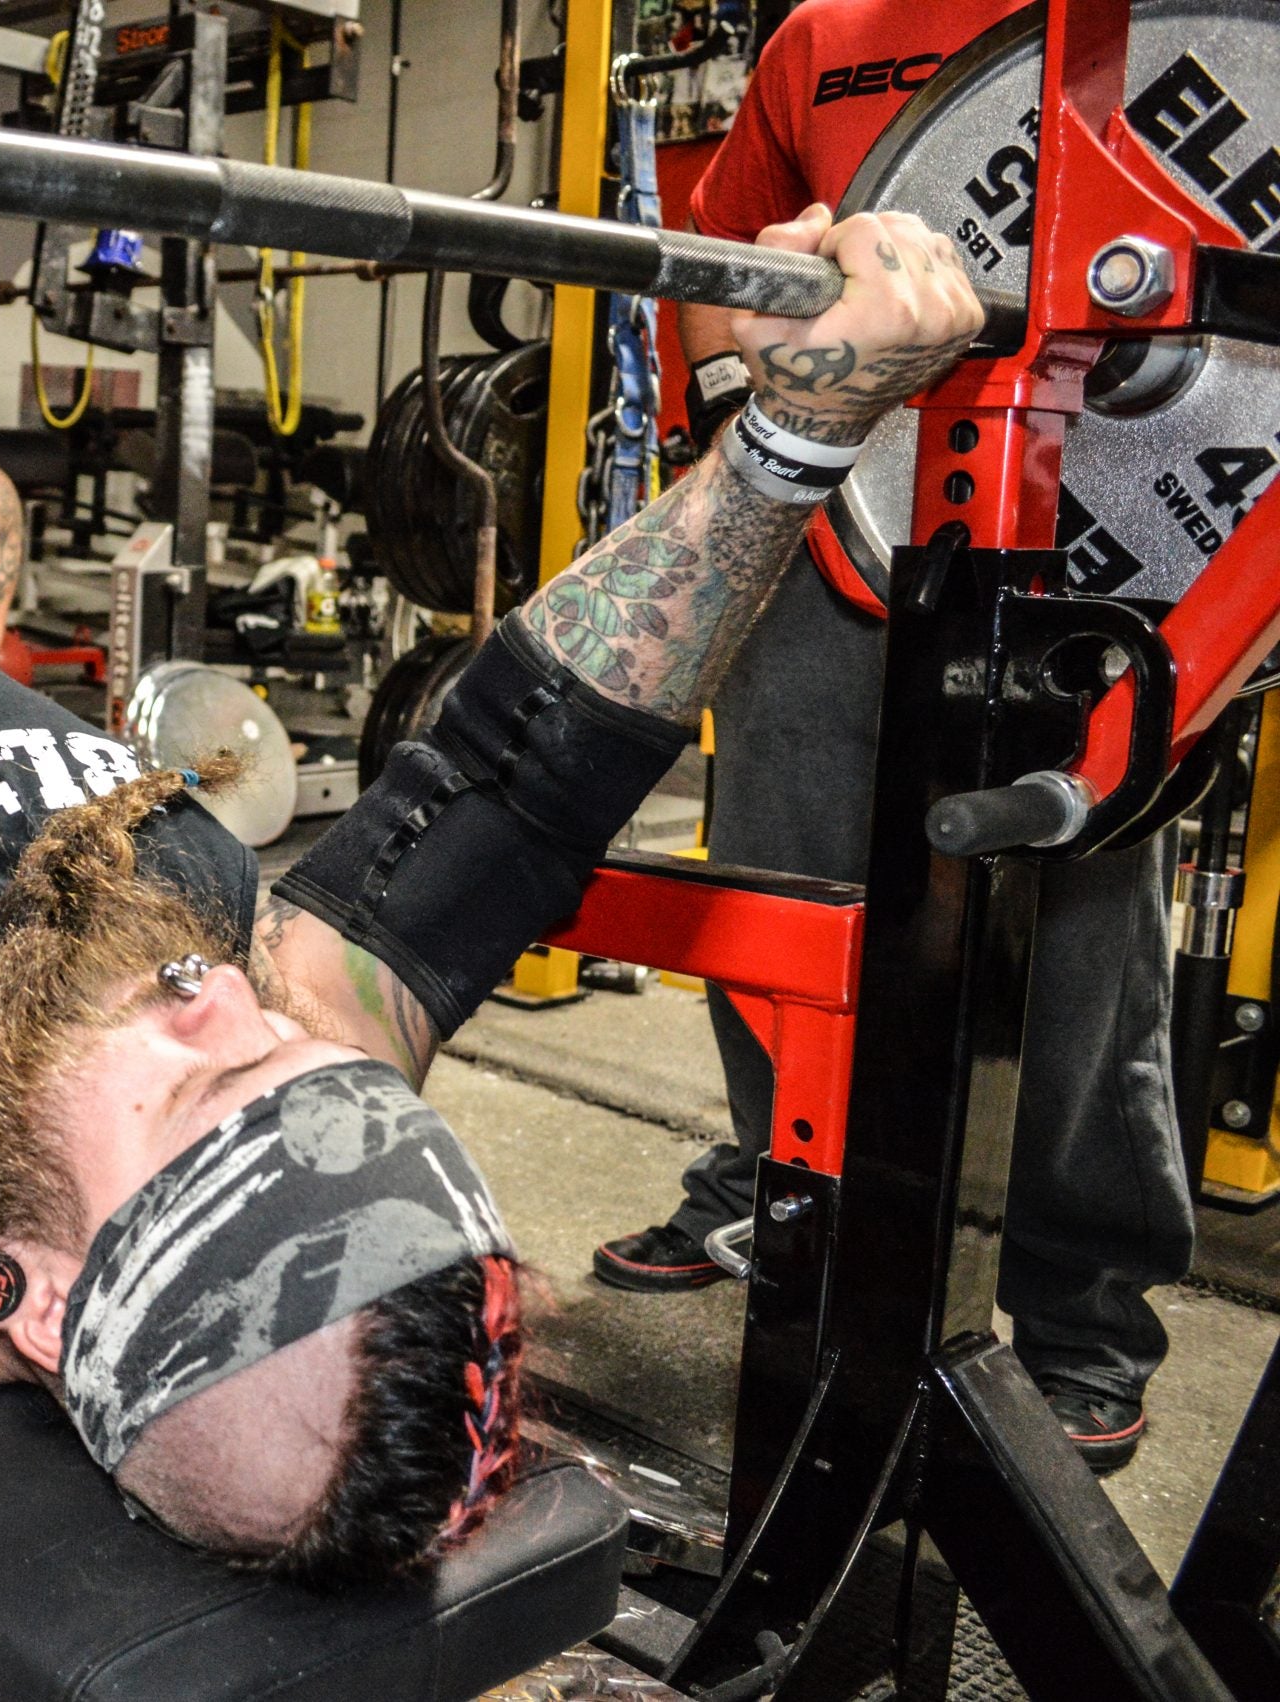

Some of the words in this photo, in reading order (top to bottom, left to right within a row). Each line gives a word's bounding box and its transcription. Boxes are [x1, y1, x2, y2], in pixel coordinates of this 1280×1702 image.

[812, 53, 942, 107] BEC
[1124, 50, 1280, 250] ELE
[956, 218, 1004, 273] LBS
[747, 414, 776, 440] Beard
[763, 458, 803, 479] Beard
[1154, 471, 1224, 560] SWED
